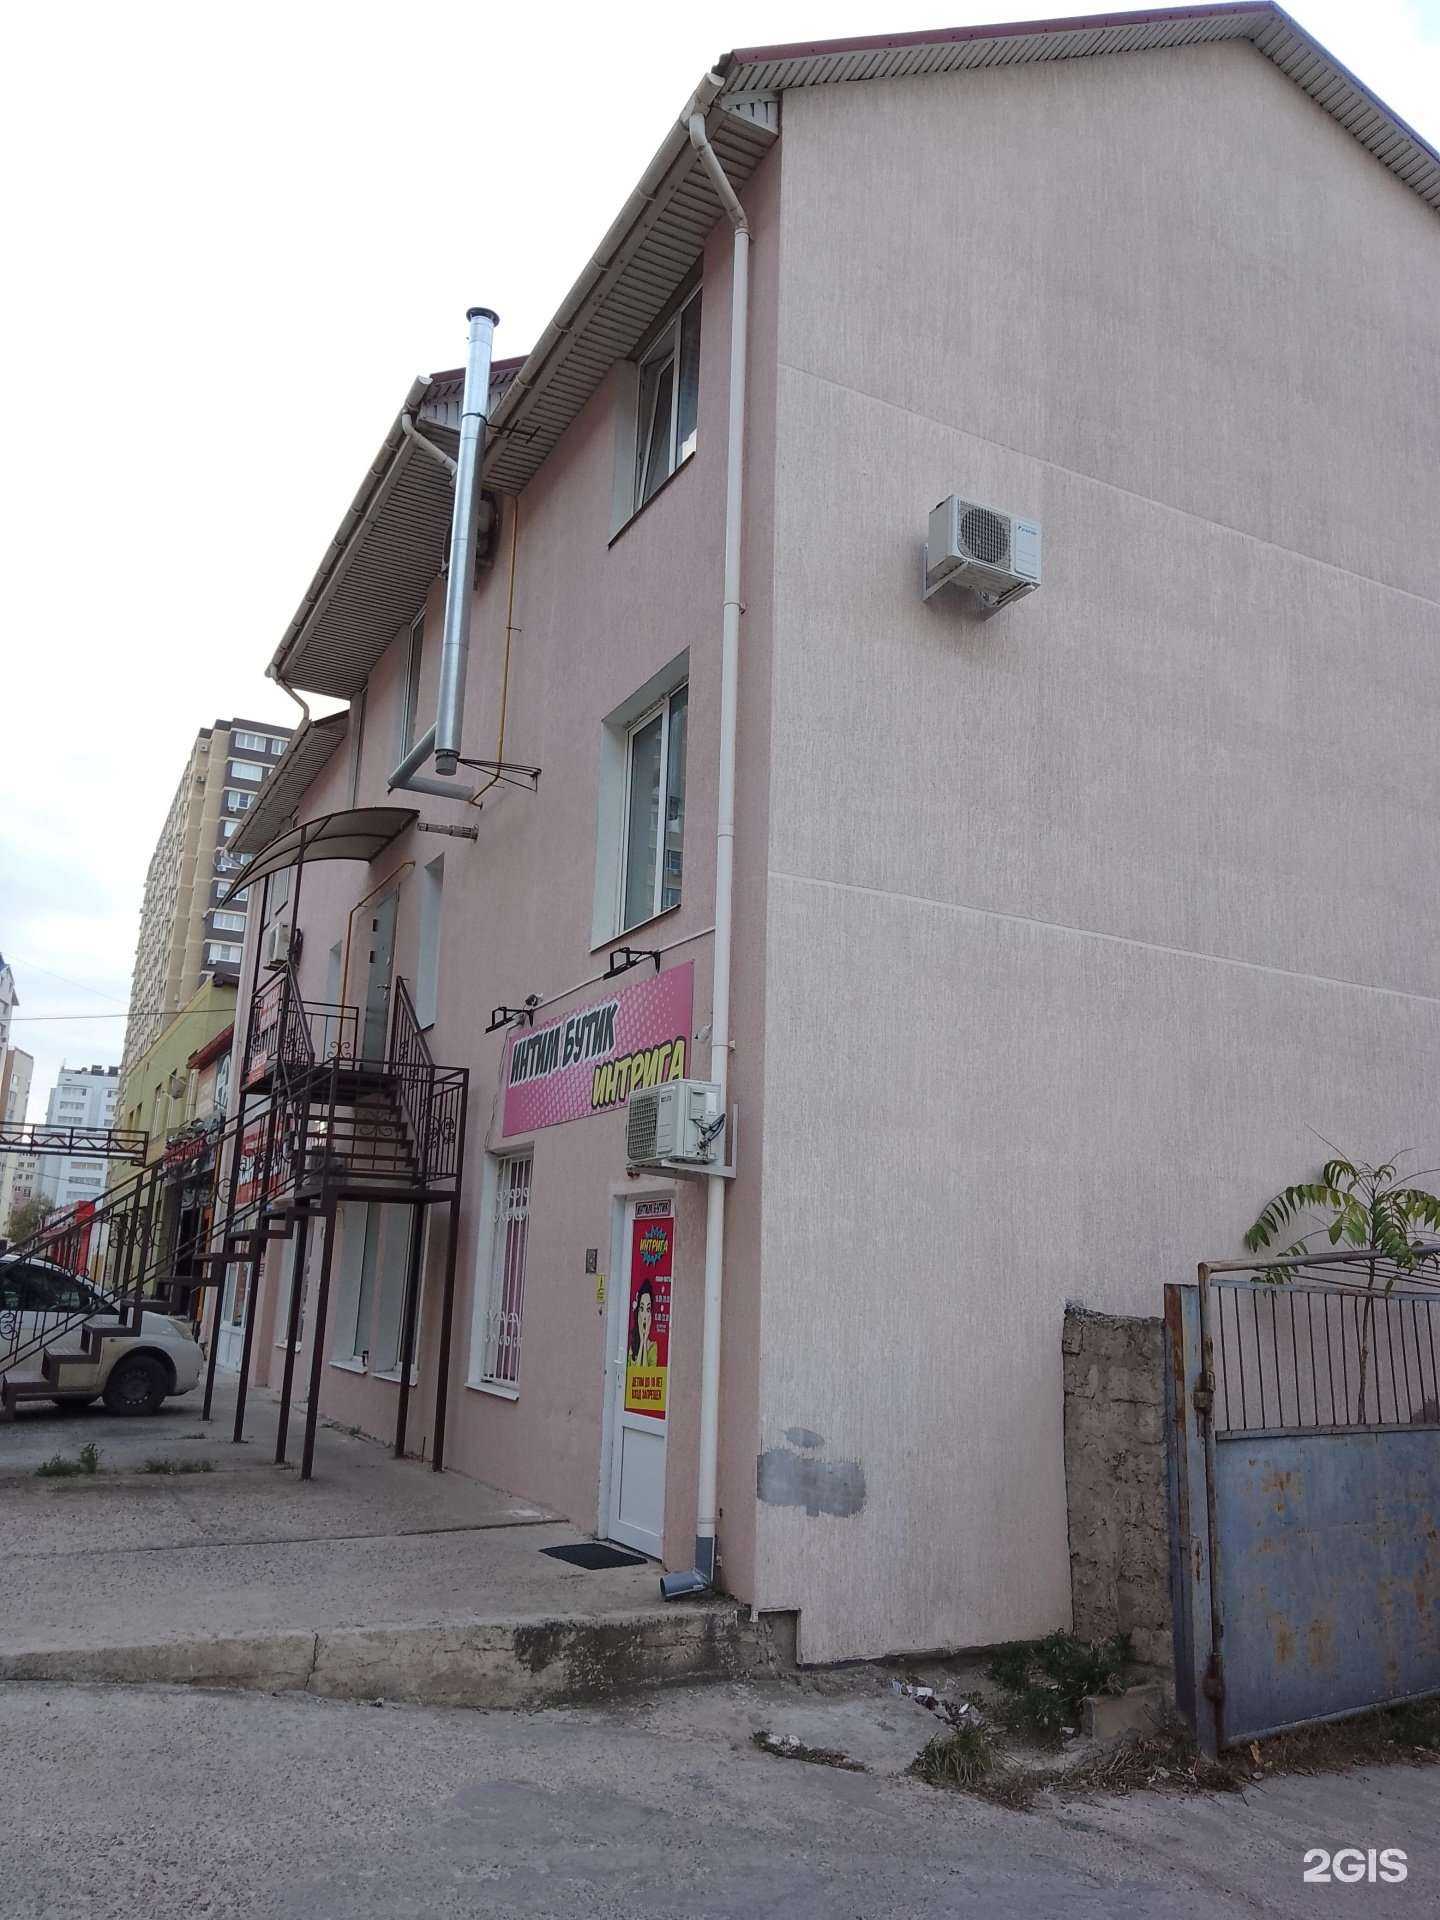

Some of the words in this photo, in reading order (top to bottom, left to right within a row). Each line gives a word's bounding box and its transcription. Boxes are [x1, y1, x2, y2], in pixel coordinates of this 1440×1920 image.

[510, 1028, 561, 1085] ИНТИМ
[561, 1002, 619, 1068] БУТИК
[592, 1036, 687, 1110] ИНТРИГА
[639, 1238, 669, 1253] ИНТРИГА
